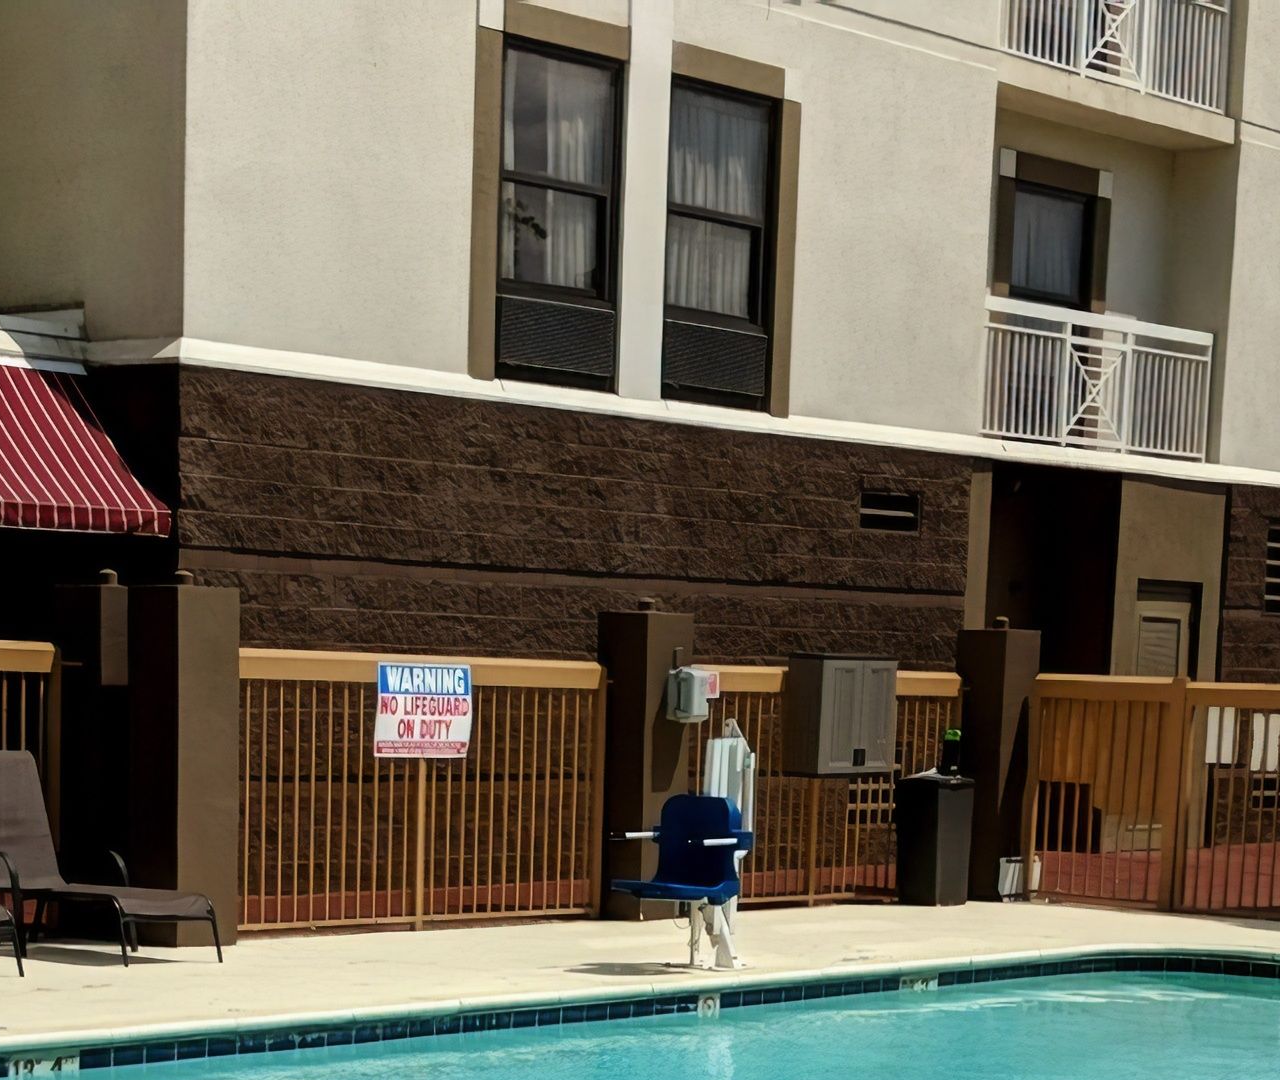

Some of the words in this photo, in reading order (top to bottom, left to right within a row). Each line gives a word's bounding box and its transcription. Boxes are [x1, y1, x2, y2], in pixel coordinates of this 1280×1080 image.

[386, 666, 465, 694] WARNING
[380, 696, 398, 715] NO
[404, 696, 470, 716] LIFEGUARD
[397, 718, 415, 739] ON
[420, 719, 452, 739] DUTY
